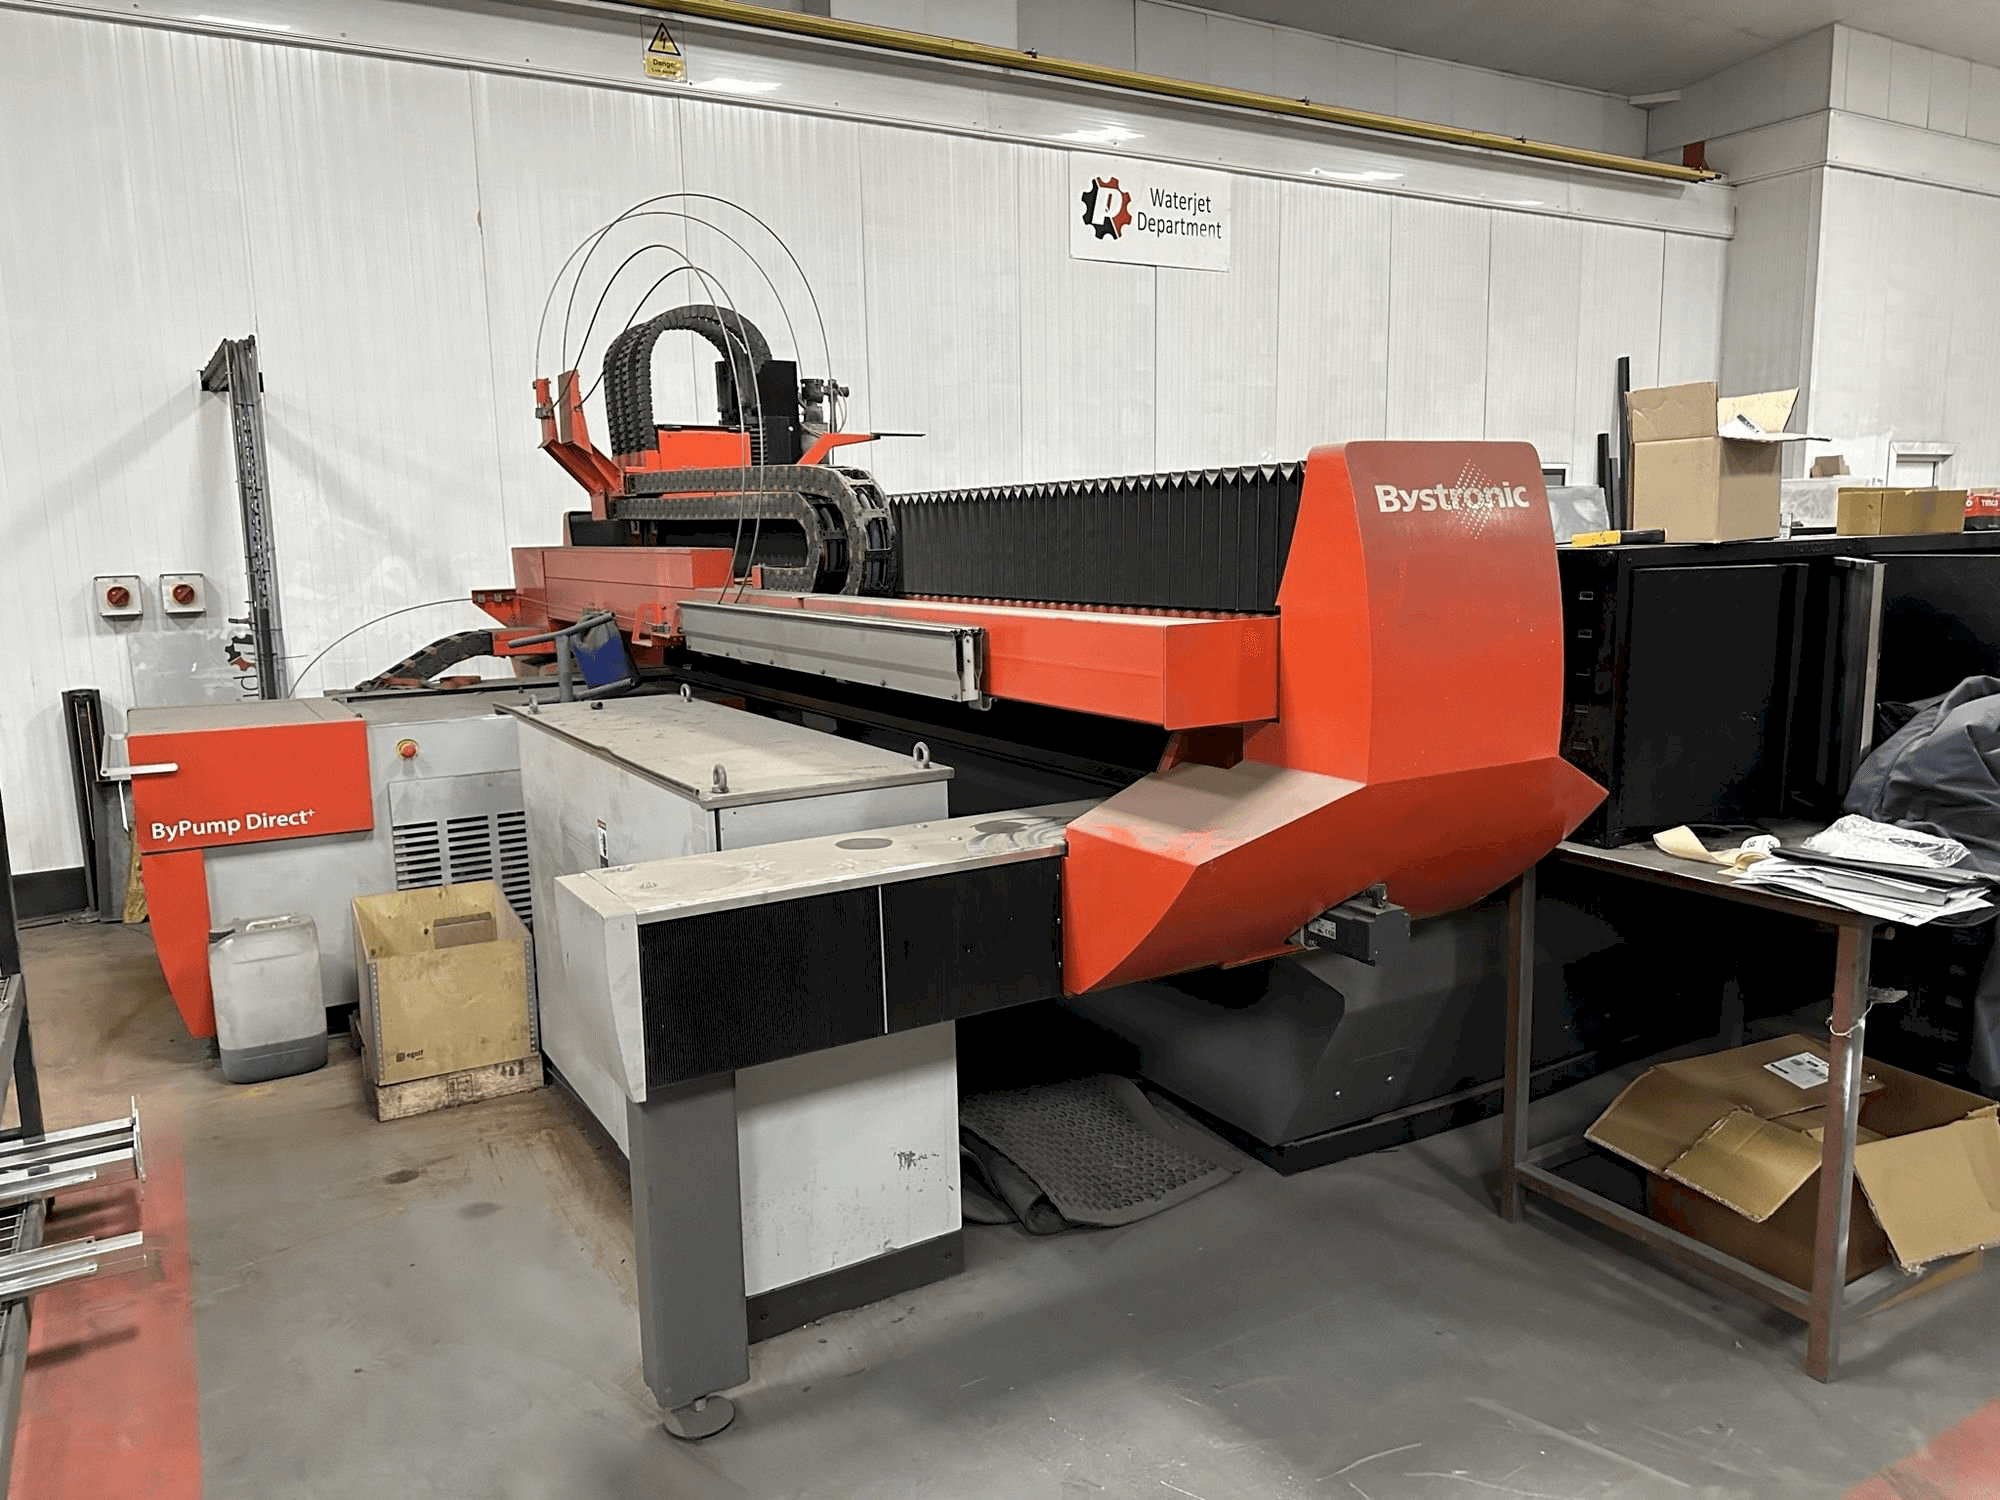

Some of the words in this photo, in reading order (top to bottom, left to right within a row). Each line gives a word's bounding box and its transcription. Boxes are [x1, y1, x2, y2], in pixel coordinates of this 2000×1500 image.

[1149, 187, 1212, 217] Waterjet
[1137, 211, 1222, 240] Department
[1374, 481, 1531, 513] Bystronic
[151, 818, 241, 843] ByPump
